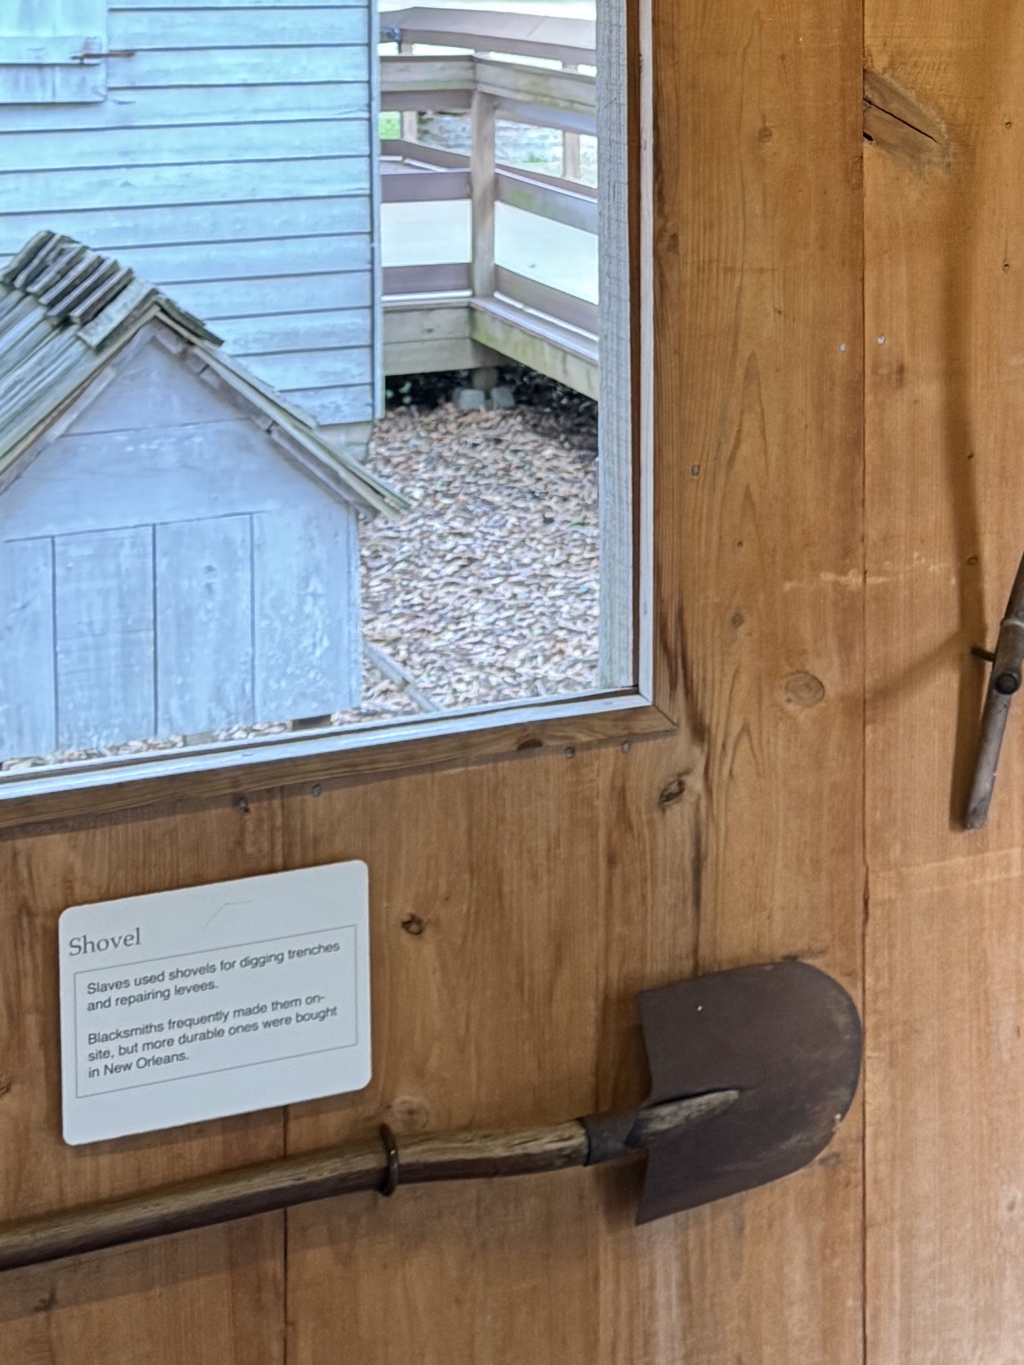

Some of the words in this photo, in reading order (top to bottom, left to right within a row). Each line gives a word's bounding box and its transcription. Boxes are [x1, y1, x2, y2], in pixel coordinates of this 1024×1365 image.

[68, 927, 141, 956] Shovel
[86, 979, 130, 994] Slaves
[133, 970, 165, 986] used
[168, 963, 217, 980] shovels
[219, 960, 237, 971] for
[239, 952, 284, 969] digging
[287, 942, 340, 959] trenches
[86, 996, 111, 1010] and
[114, 988, 171, 1006] repairing
[173, 980, 218, 995] levees.
[87, 1022, 164, 1043] Blacksmiths
[167, 1011, 230, 1030] frequently
[232, 1004, 267, 1018] made
[270, 998, 302, 1011] them
[304, 997, 325, 1005] on-
[87, 1049, 114, 1061] site,
[117, 1042, 138, 1055] but
[141, 1039, 175, 1051] more
[177, 1028, 225, 1045] durable
[227, 1025, 259, 1036] ones
[261, 1019, 292, 1029] were
[295, 1008, 337, 1023] bought
[88, 1067, 100, 1077] in
[103, 1062, 133, 1074] New
[135, 1051, 189, 1069] Orleans.
